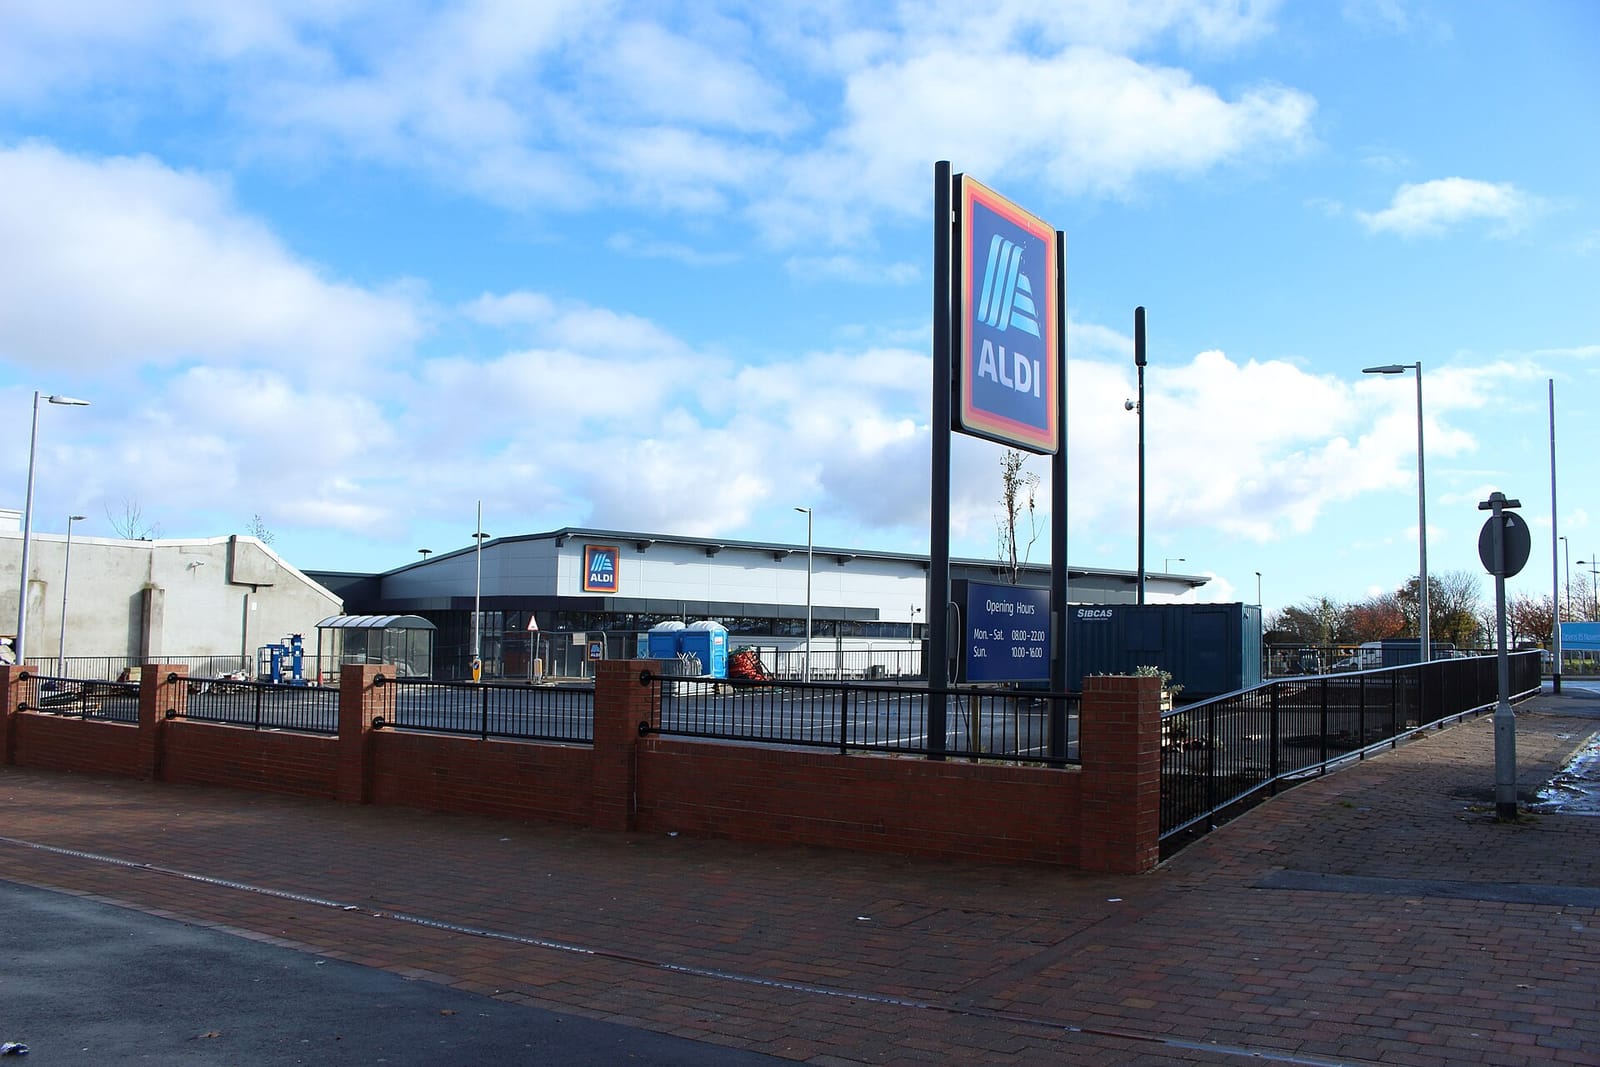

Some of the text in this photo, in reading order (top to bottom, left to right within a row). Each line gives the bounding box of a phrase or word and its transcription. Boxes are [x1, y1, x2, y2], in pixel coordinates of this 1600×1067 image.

[978, 338, 1040, 398] ALDI
[590, 573, 613, 583] ALDI
[986, 599, 1035, 617] Opening Hours
[1077, 608, 1113, 618] SIBCAS
[973, 645, 988, 658] Sun.
